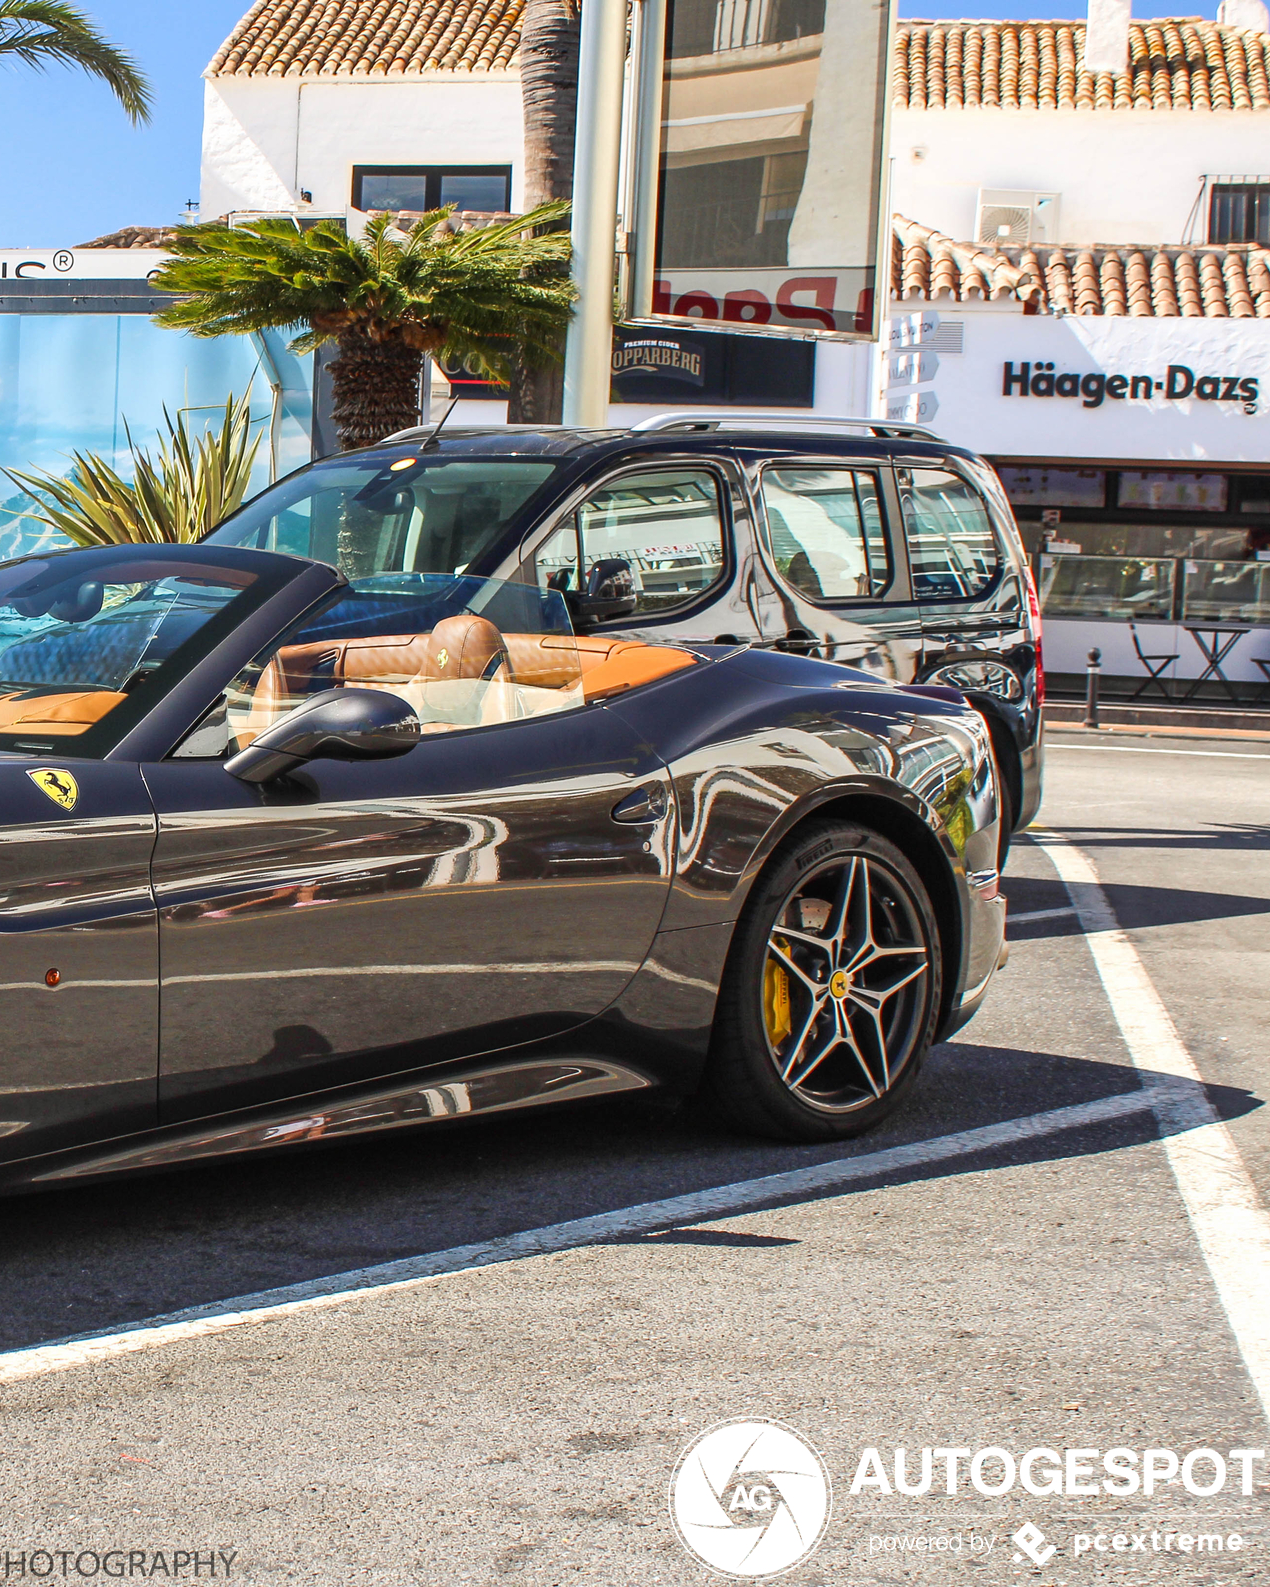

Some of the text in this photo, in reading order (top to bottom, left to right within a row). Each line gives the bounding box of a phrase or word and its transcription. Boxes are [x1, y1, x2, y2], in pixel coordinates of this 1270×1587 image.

[624, 340, 680, 349] PREMIUM CIDER
[611, 347, 701, 376] OPPARBERG
